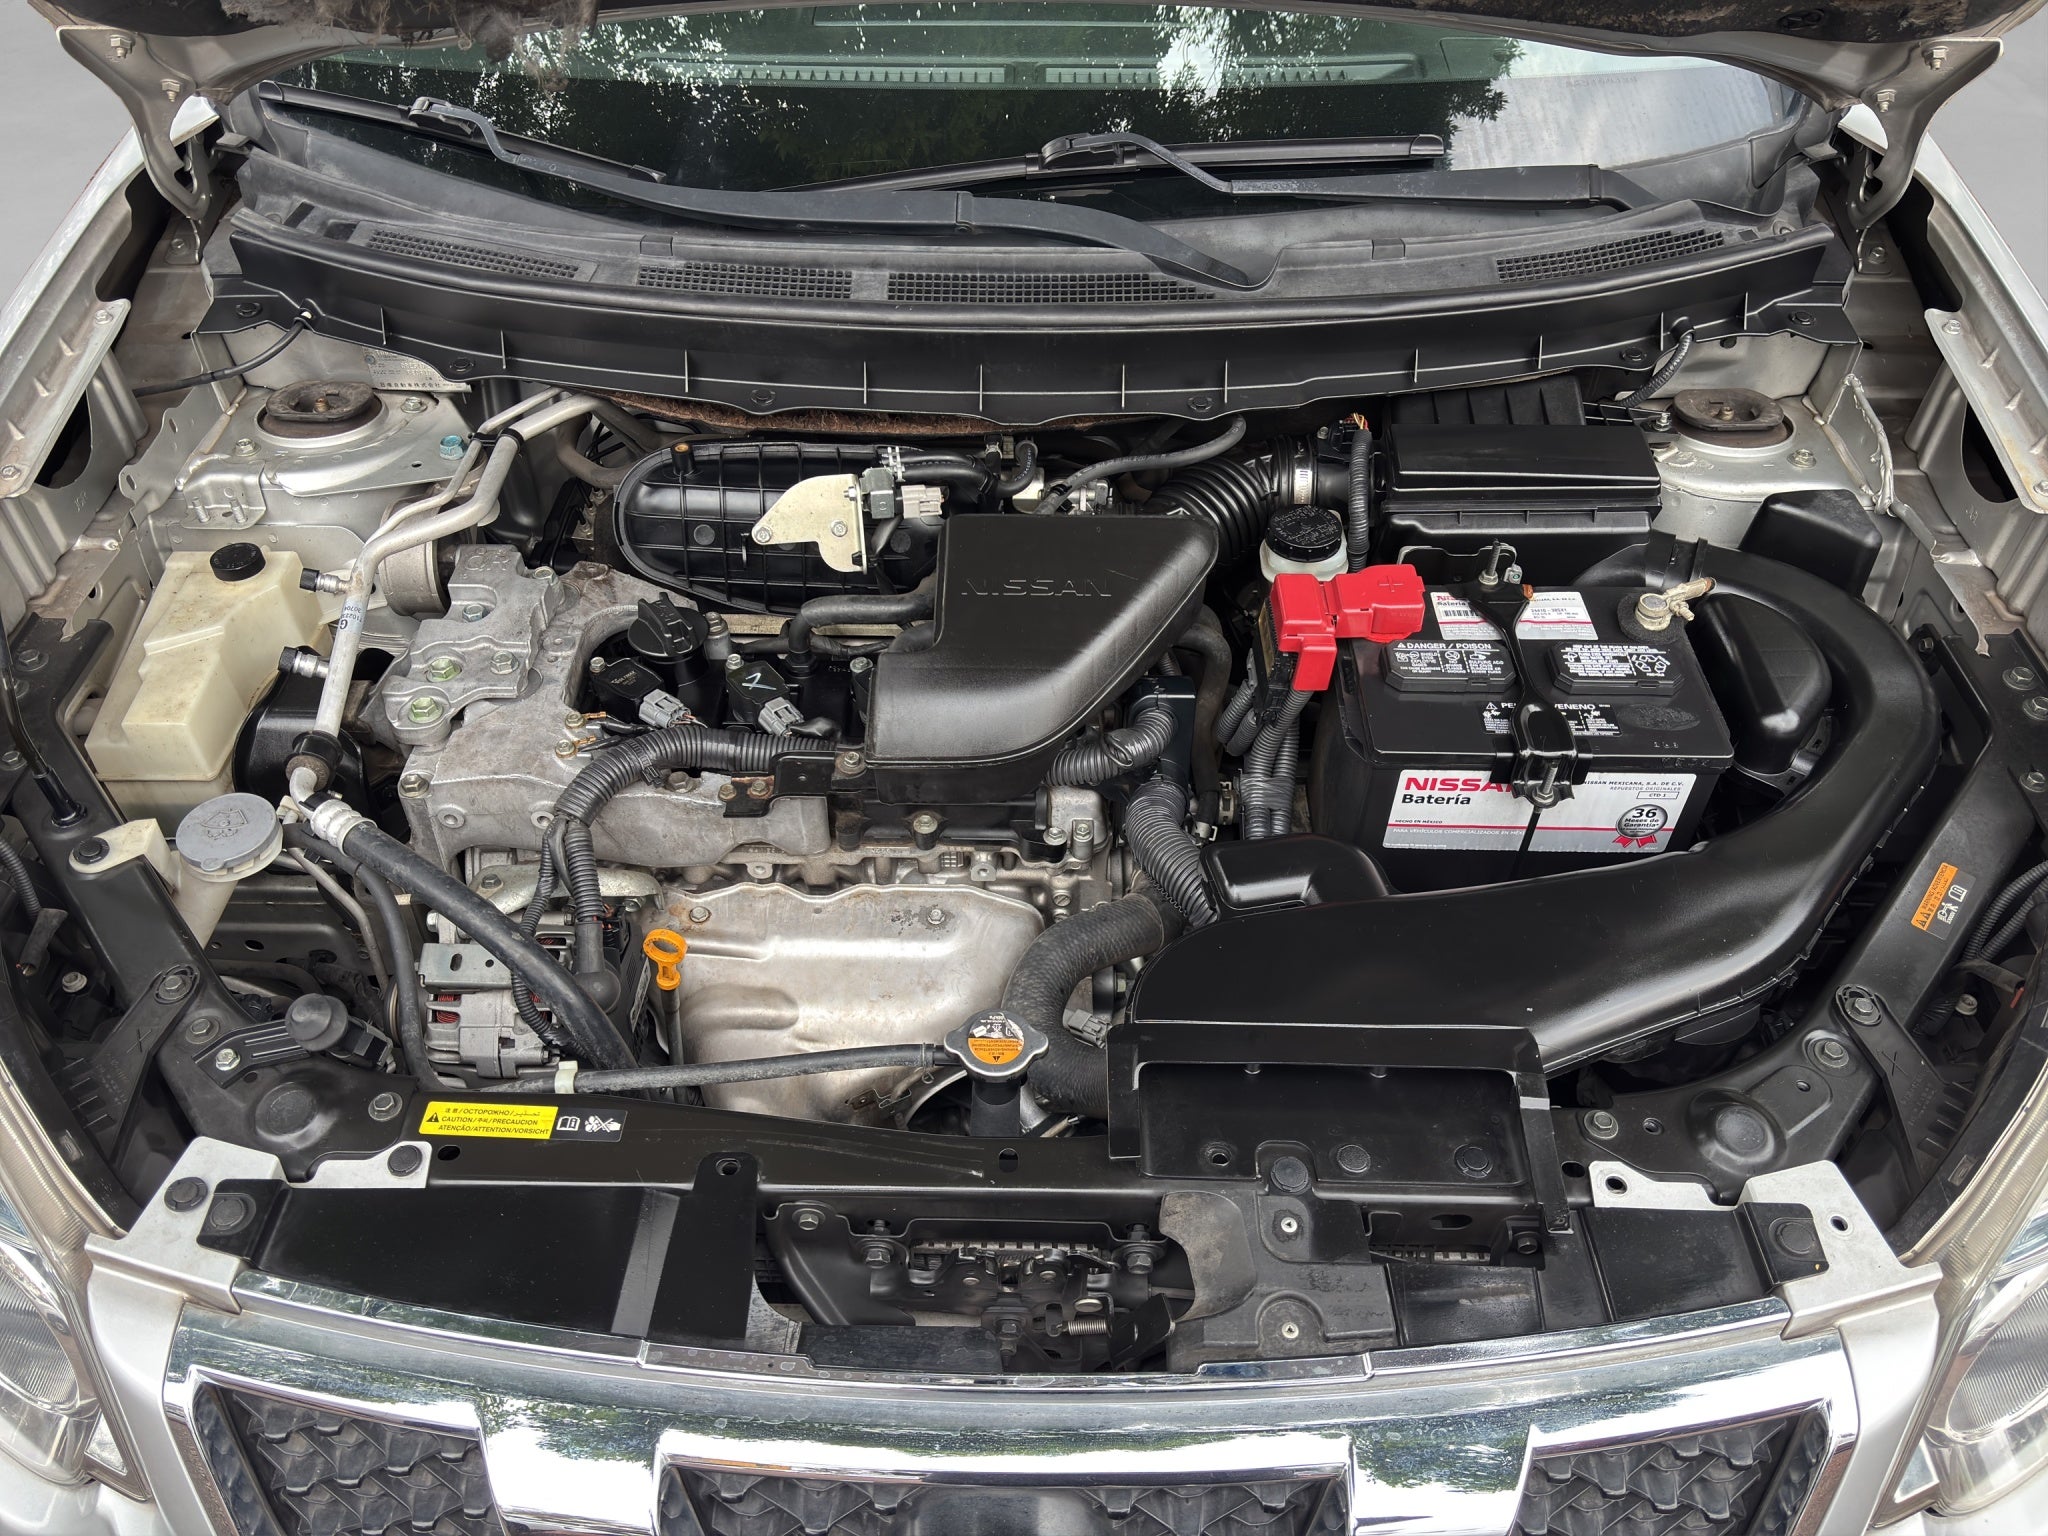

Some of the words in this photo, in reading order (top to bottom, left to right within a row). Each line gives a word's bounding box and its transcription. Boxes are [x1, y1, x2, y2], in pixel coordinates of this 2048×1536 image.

[961, 576, 1112, 597] NISSAN
[1404, 778, 1514, 792] NISSA
[1402, 794, 1471, 804] Batería
[1632, 808, 1658, 818] 36
